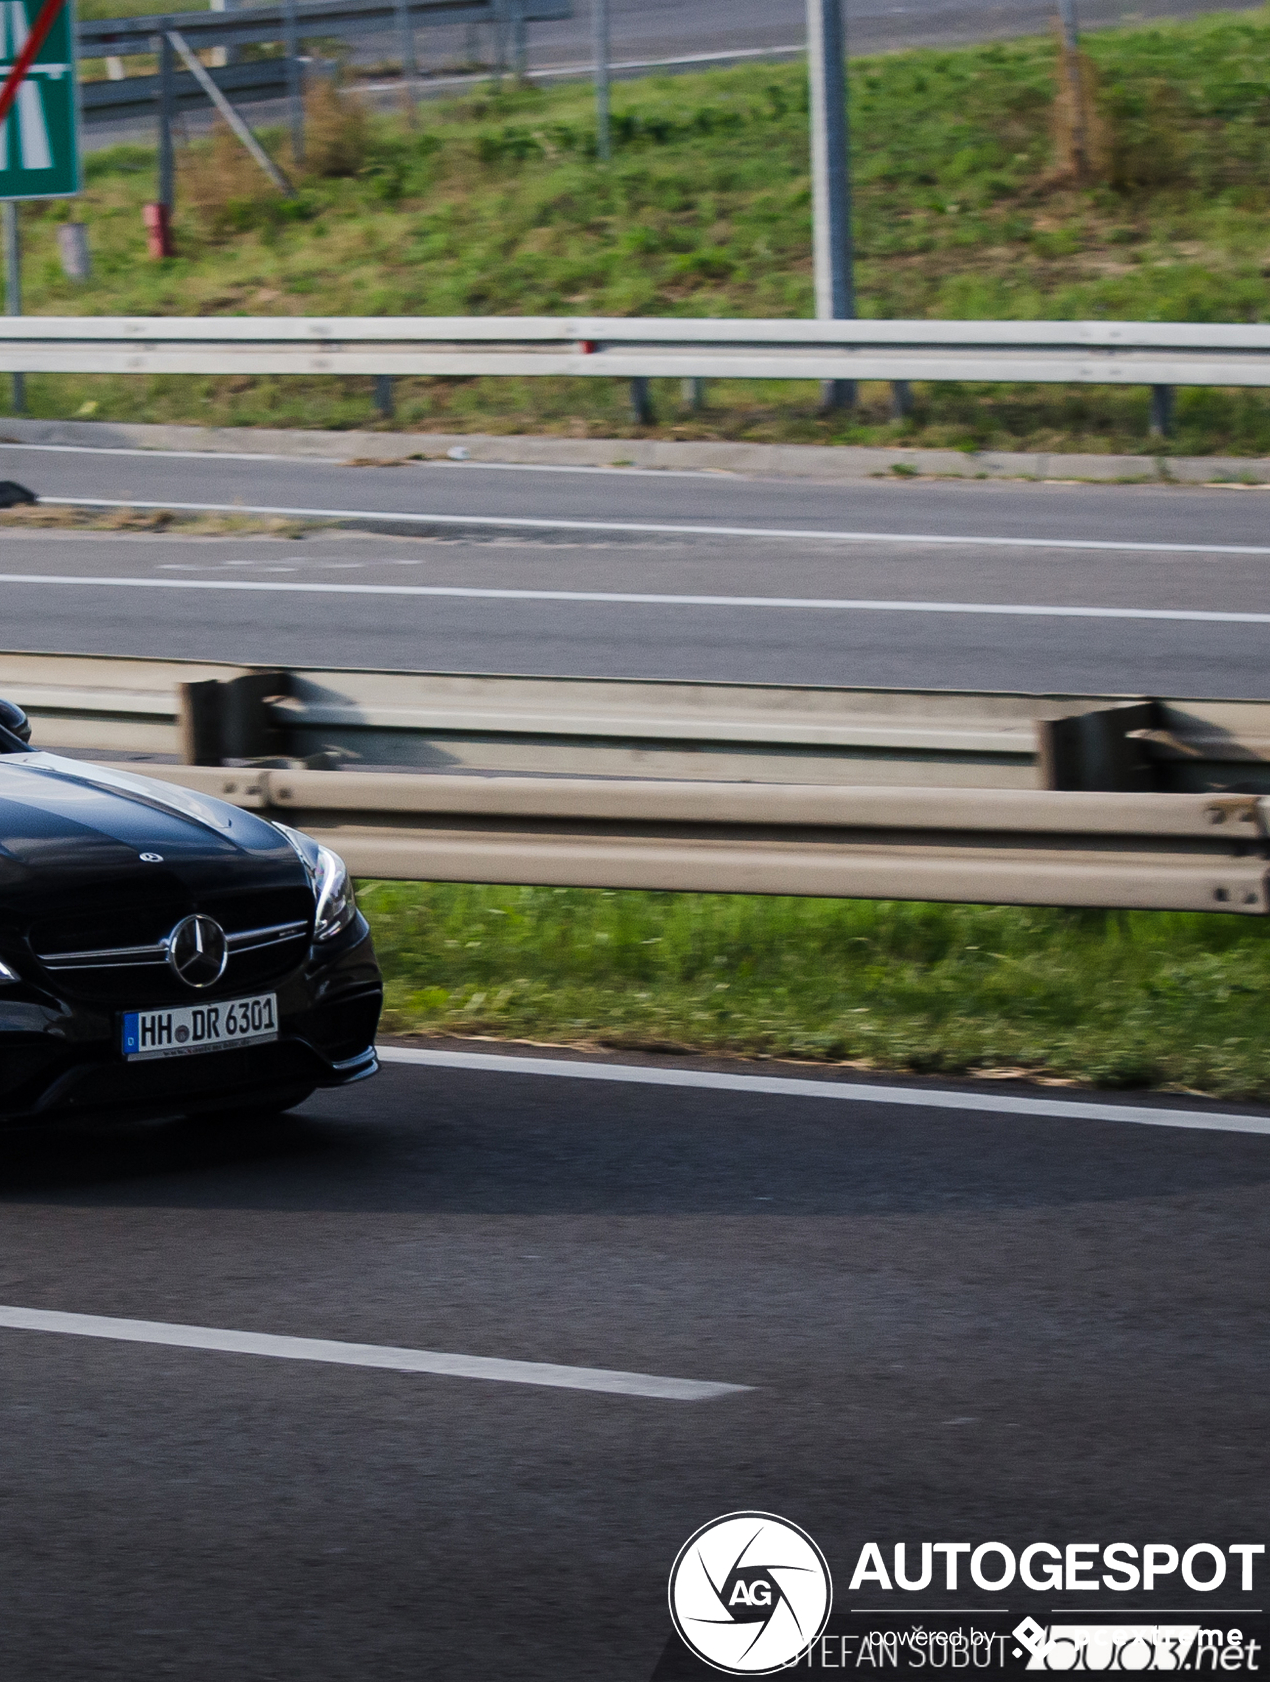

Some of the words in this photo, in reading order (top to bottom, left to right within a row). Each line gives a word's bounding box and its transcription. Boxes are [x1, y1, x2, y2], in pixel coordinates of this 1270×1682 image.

[141, 1014, 172, 1046] HH
[192, 1008, 220, 1041] DR
[226, 998, 274, 1035] 6301
